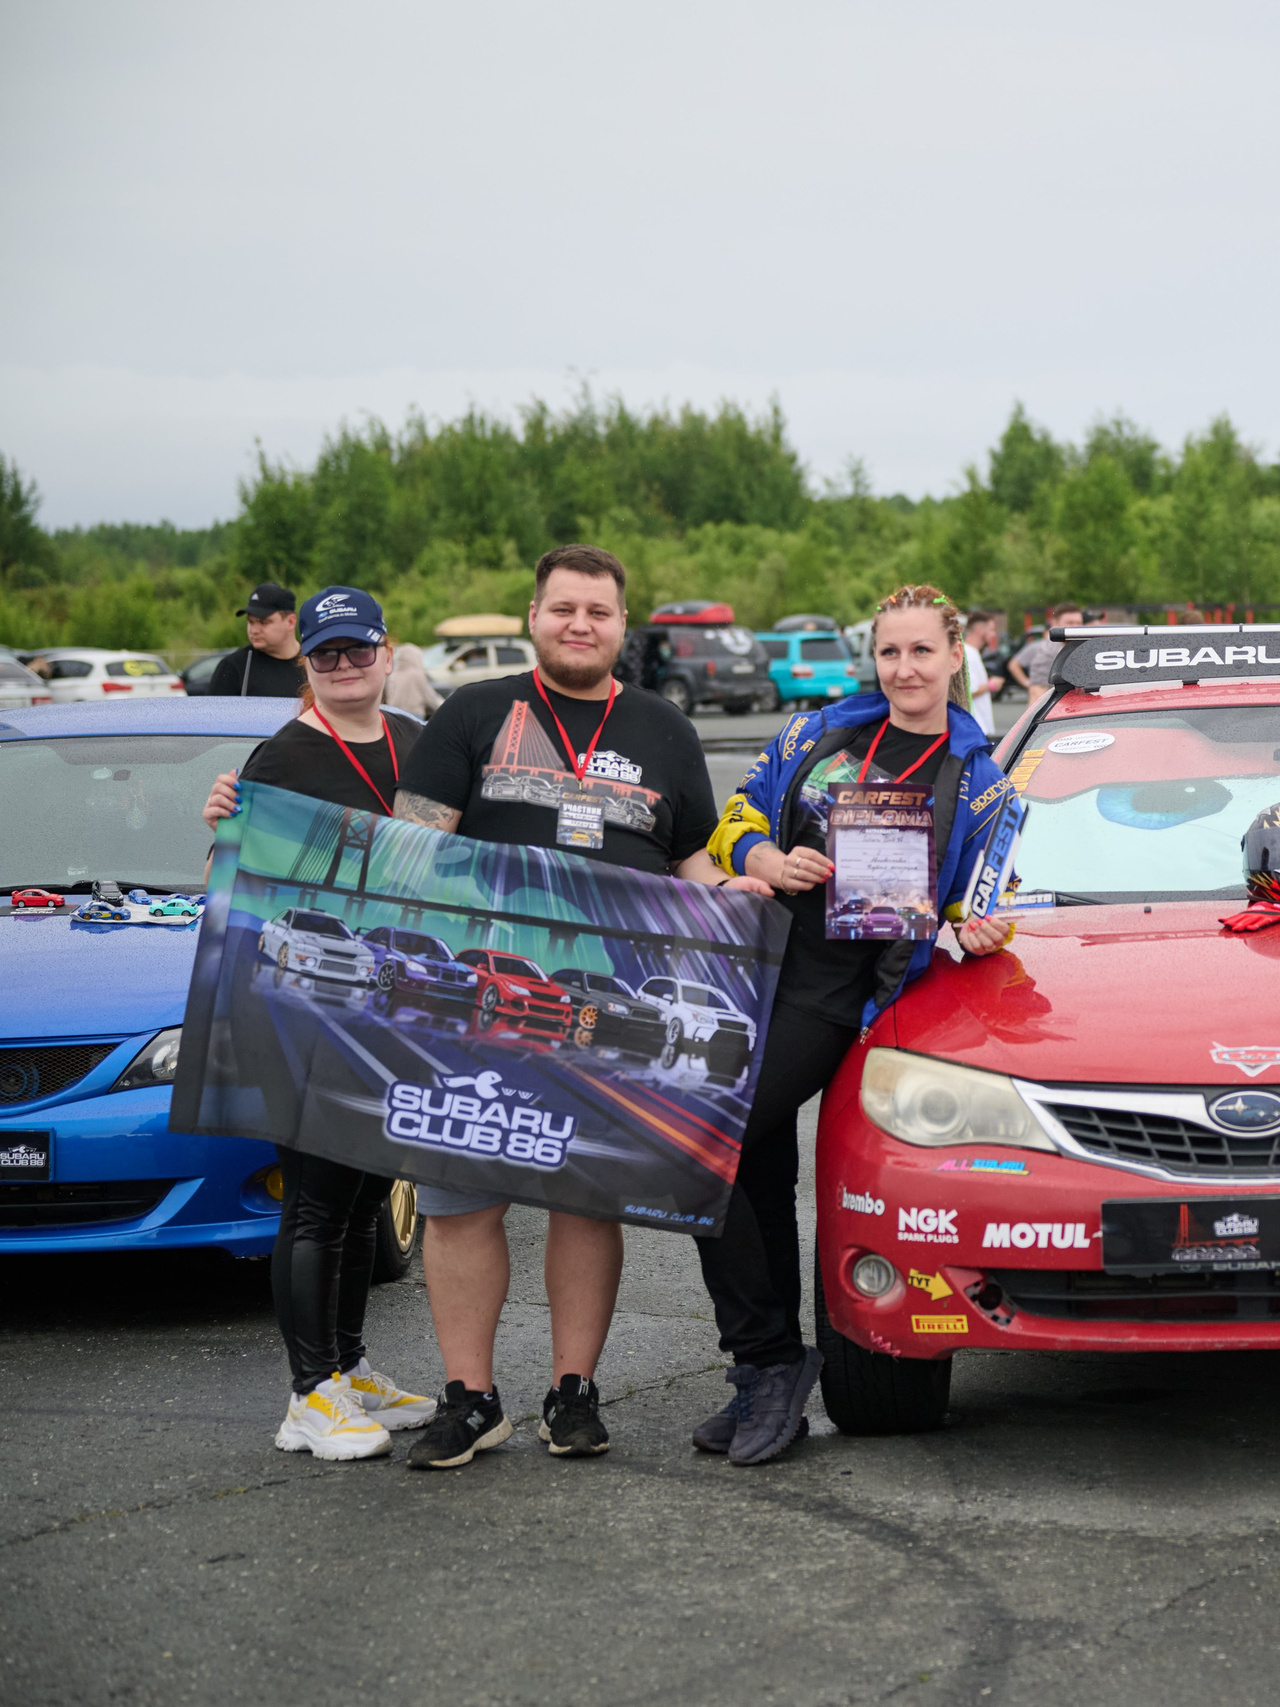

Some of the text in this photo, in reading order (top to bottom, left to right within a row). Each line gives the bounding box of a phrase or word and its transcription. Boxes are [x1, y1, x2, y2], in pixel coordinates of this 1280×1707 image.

[1054, 738, 1109, 748] CARFEST
[837, 791, 926, 806] CARFEST
[969, 777, 1011, 812] sparco
[830, 809, 933, 827] DIPLOMA
[972, 806, 1020, 918] CARFEST
[391, 1083, 574, 1140] SUBARU
[390, 1112, 564, 1164] CLUB 86
[842, 1186, 885, 1215] brembo
[898, 1207, 958, 1234] NGK
[897, 1231, 959, 1244] SPARK PLUGS
[982, 1222, 1090, 1248] MOTUL
[914, 1317, 965, 1330] PIRELLI
